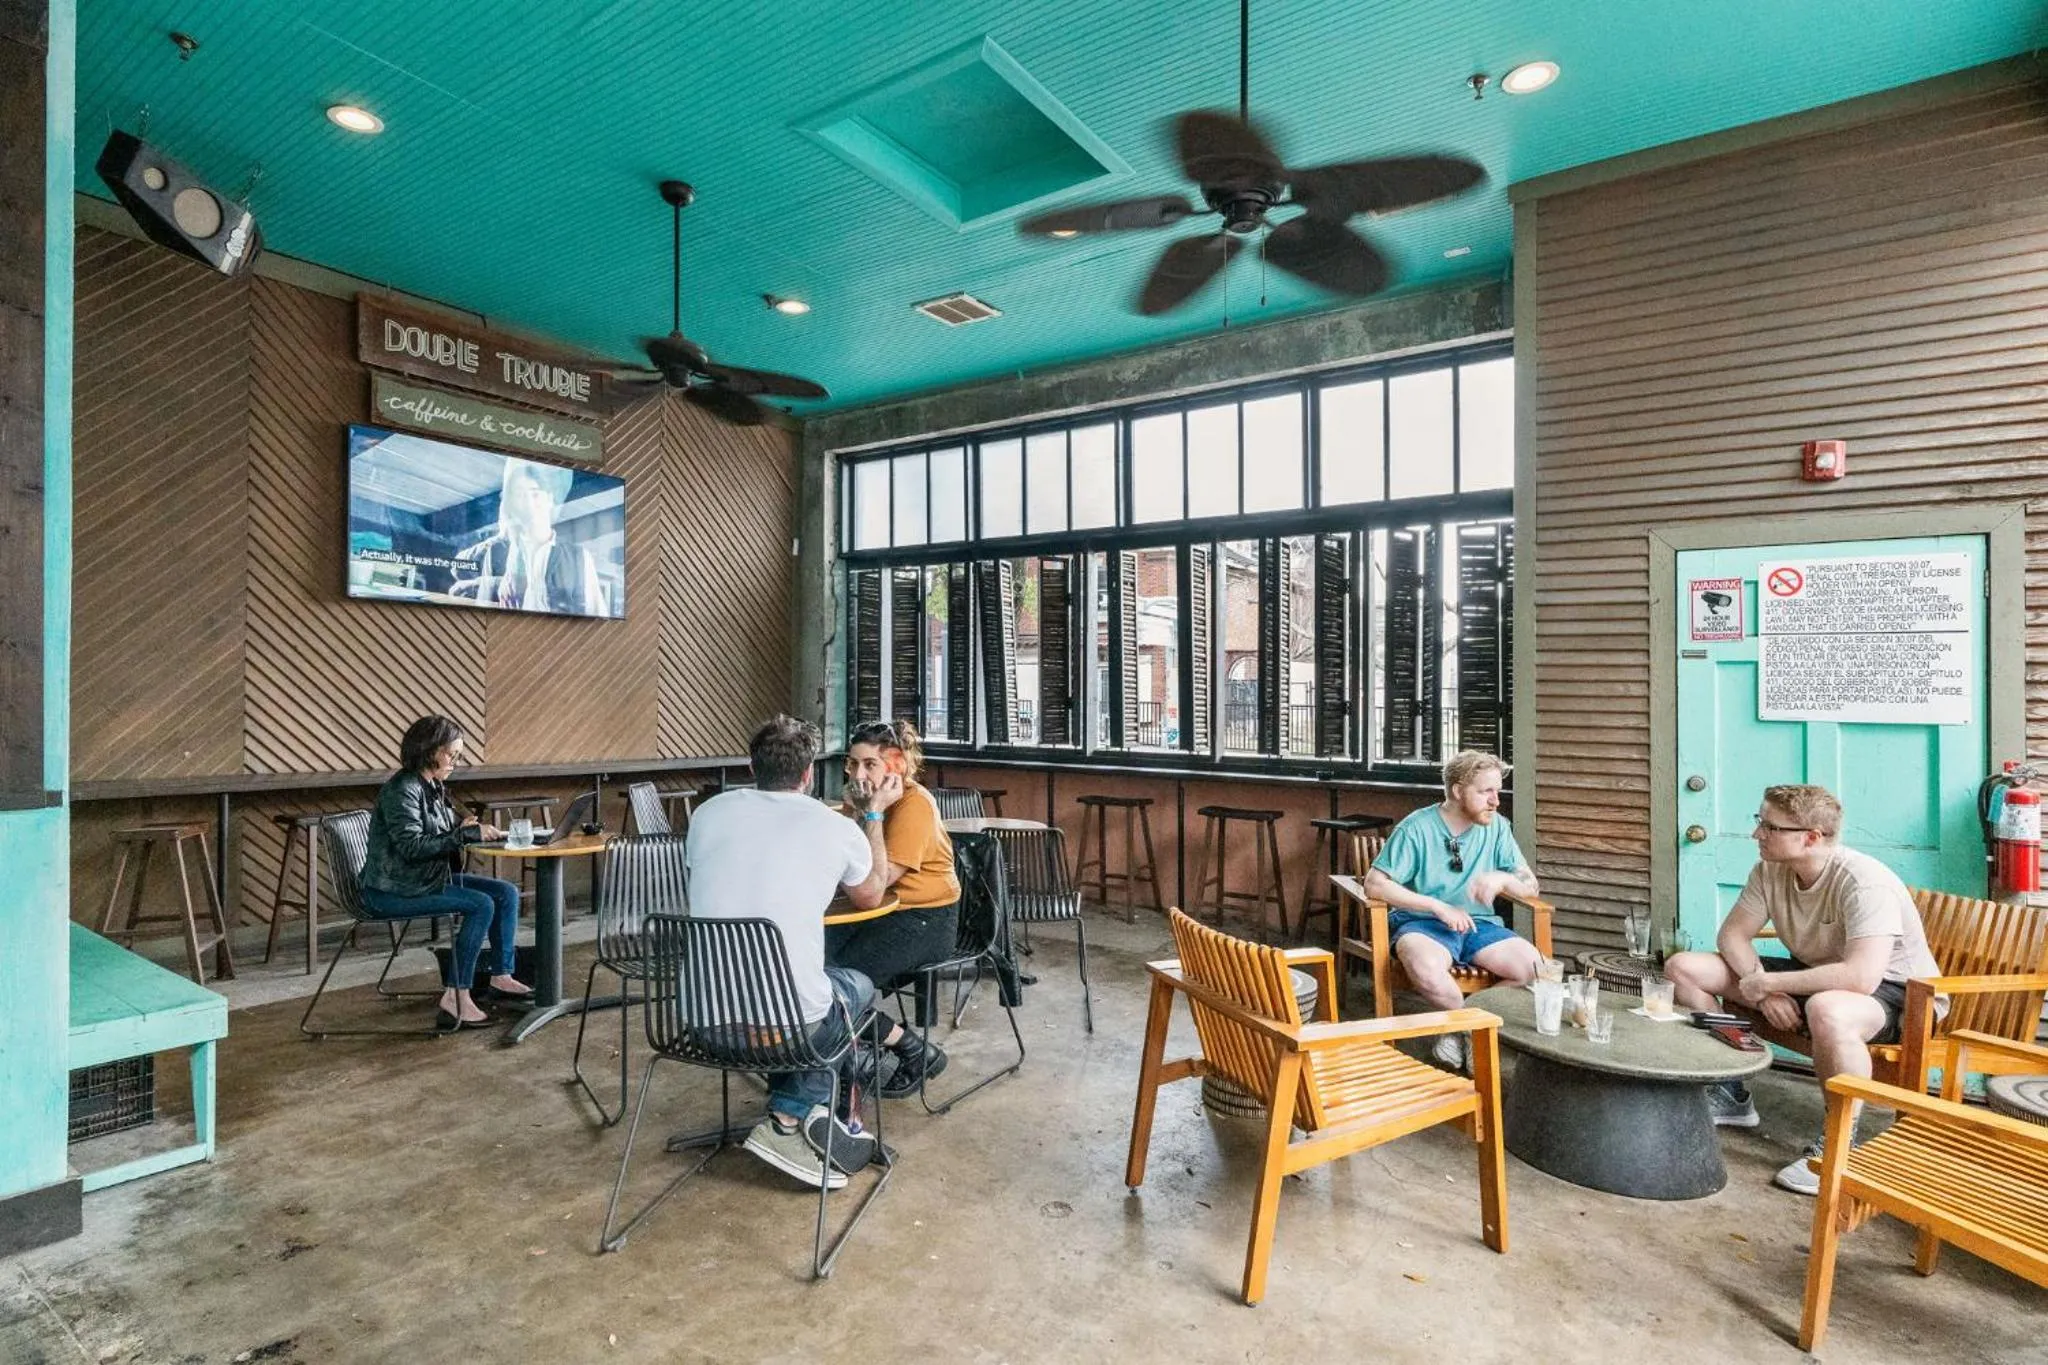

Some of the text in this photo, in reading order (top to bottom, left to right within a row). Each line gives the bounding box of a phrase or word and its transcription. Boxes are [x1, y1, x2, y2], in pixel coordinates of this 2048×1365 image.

[385, 319, 591, 402] DOUBLE TROUBLE
[384, 396, 592, 450] caffeine & cocktails
[361, 549, 479, 571] Actually, it was the guard.
[1855, 563, 1867, 571] TO
[1909, 570, 1921, 578] BY
[1923, 568, 1961, 577] LICENSE
[1692, 581, 1740, 590] WARNING
[1864, 580, 1877, 588] AN
[1878, 579, 1912, 587] OPENLY
[1901, 586, 1938, 595] PERSON
[1907, 595, 1950, 604] CHAPTER
[1915, 603, 1964, 612] LICENSING
[1856, 613, 1875, 621] THIS
[1877, 612, 1924, 621] PROPERTY
[1927, 612, 1949, 620] WITH
[1950, 612, 1958, 620] A
[1808, 623, 1828, 631] THAT
[1822, 635, 1841, 643] CON
[1910, 661, 1930, 669] CON
[1916, 687, 1930, 696] NO
[1932, 686, 1963, 696] PUEDE
[1910, 696, 1929, 704] UNA
